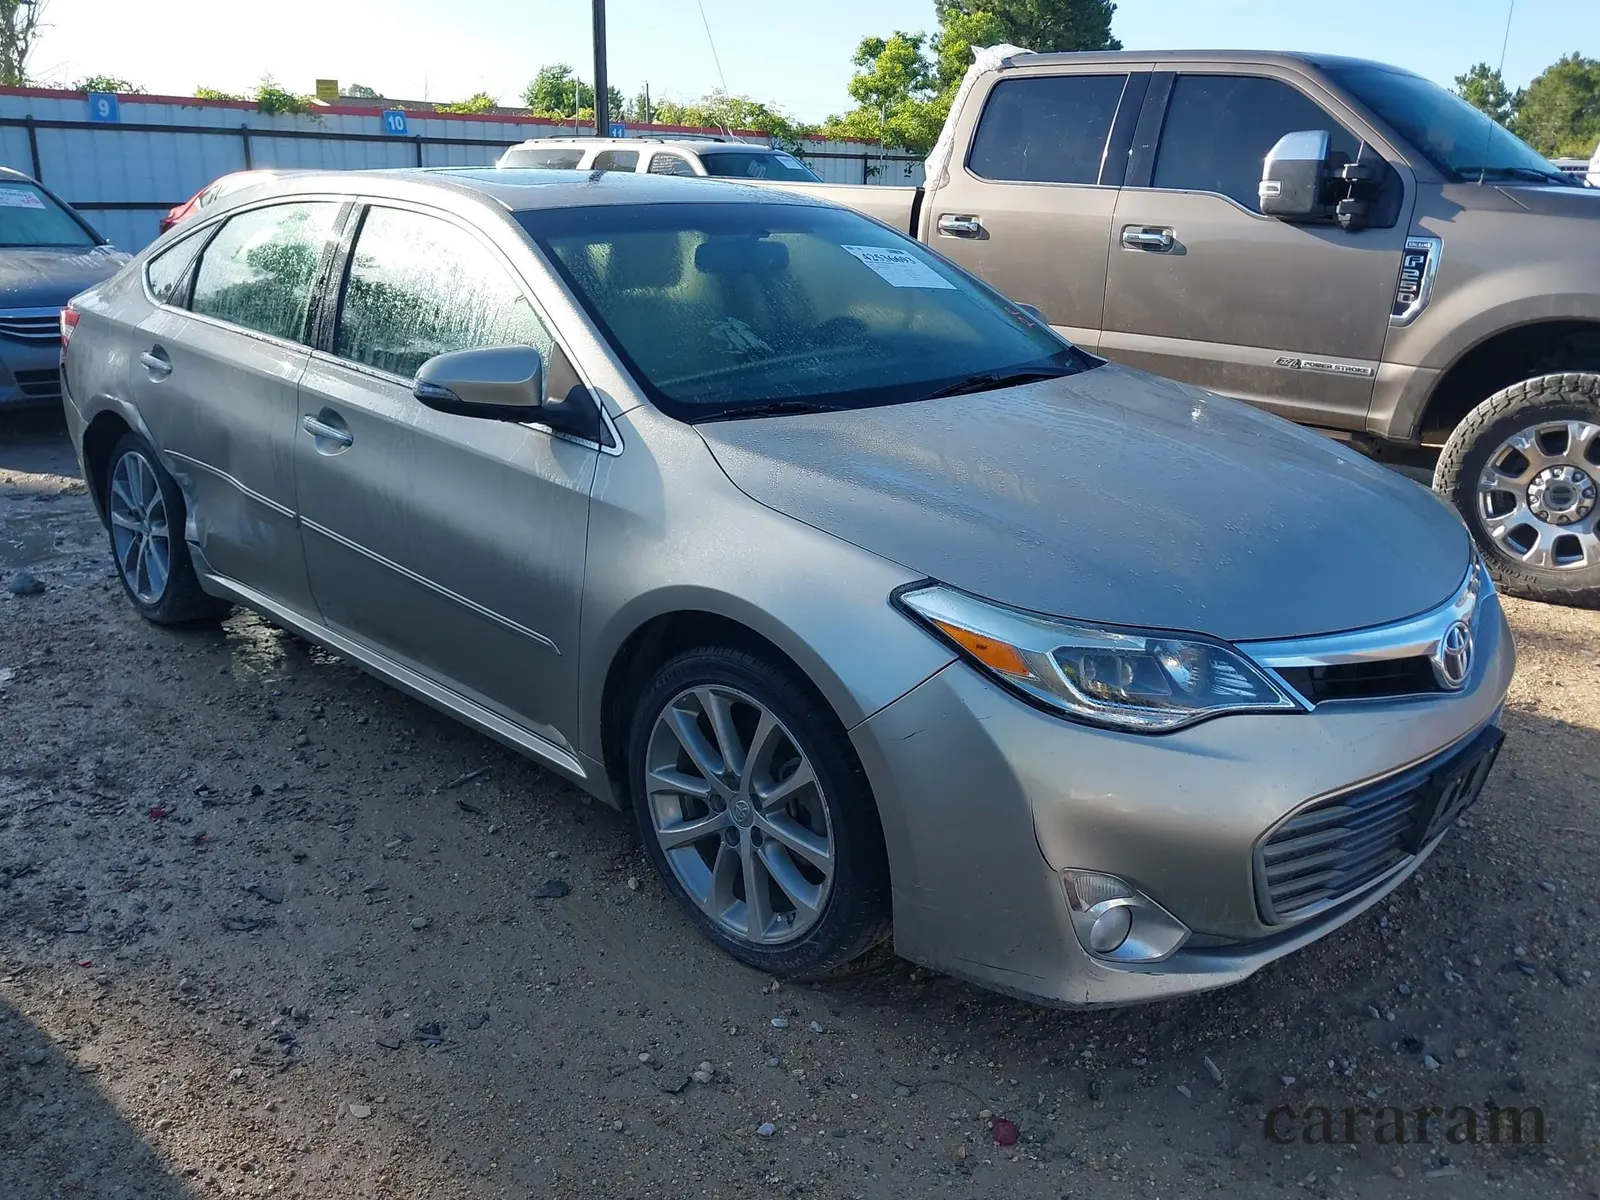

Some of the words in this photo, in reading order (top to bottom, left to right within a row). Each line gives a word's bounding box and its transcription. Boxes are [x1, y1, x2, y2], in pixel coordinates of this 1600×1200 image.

[97, 98, 110, 117] 9
[388, 115, 404, 131] 10
[611, 128, 623, 138] 11
[1334, 365, 1370, 373] STROKE
